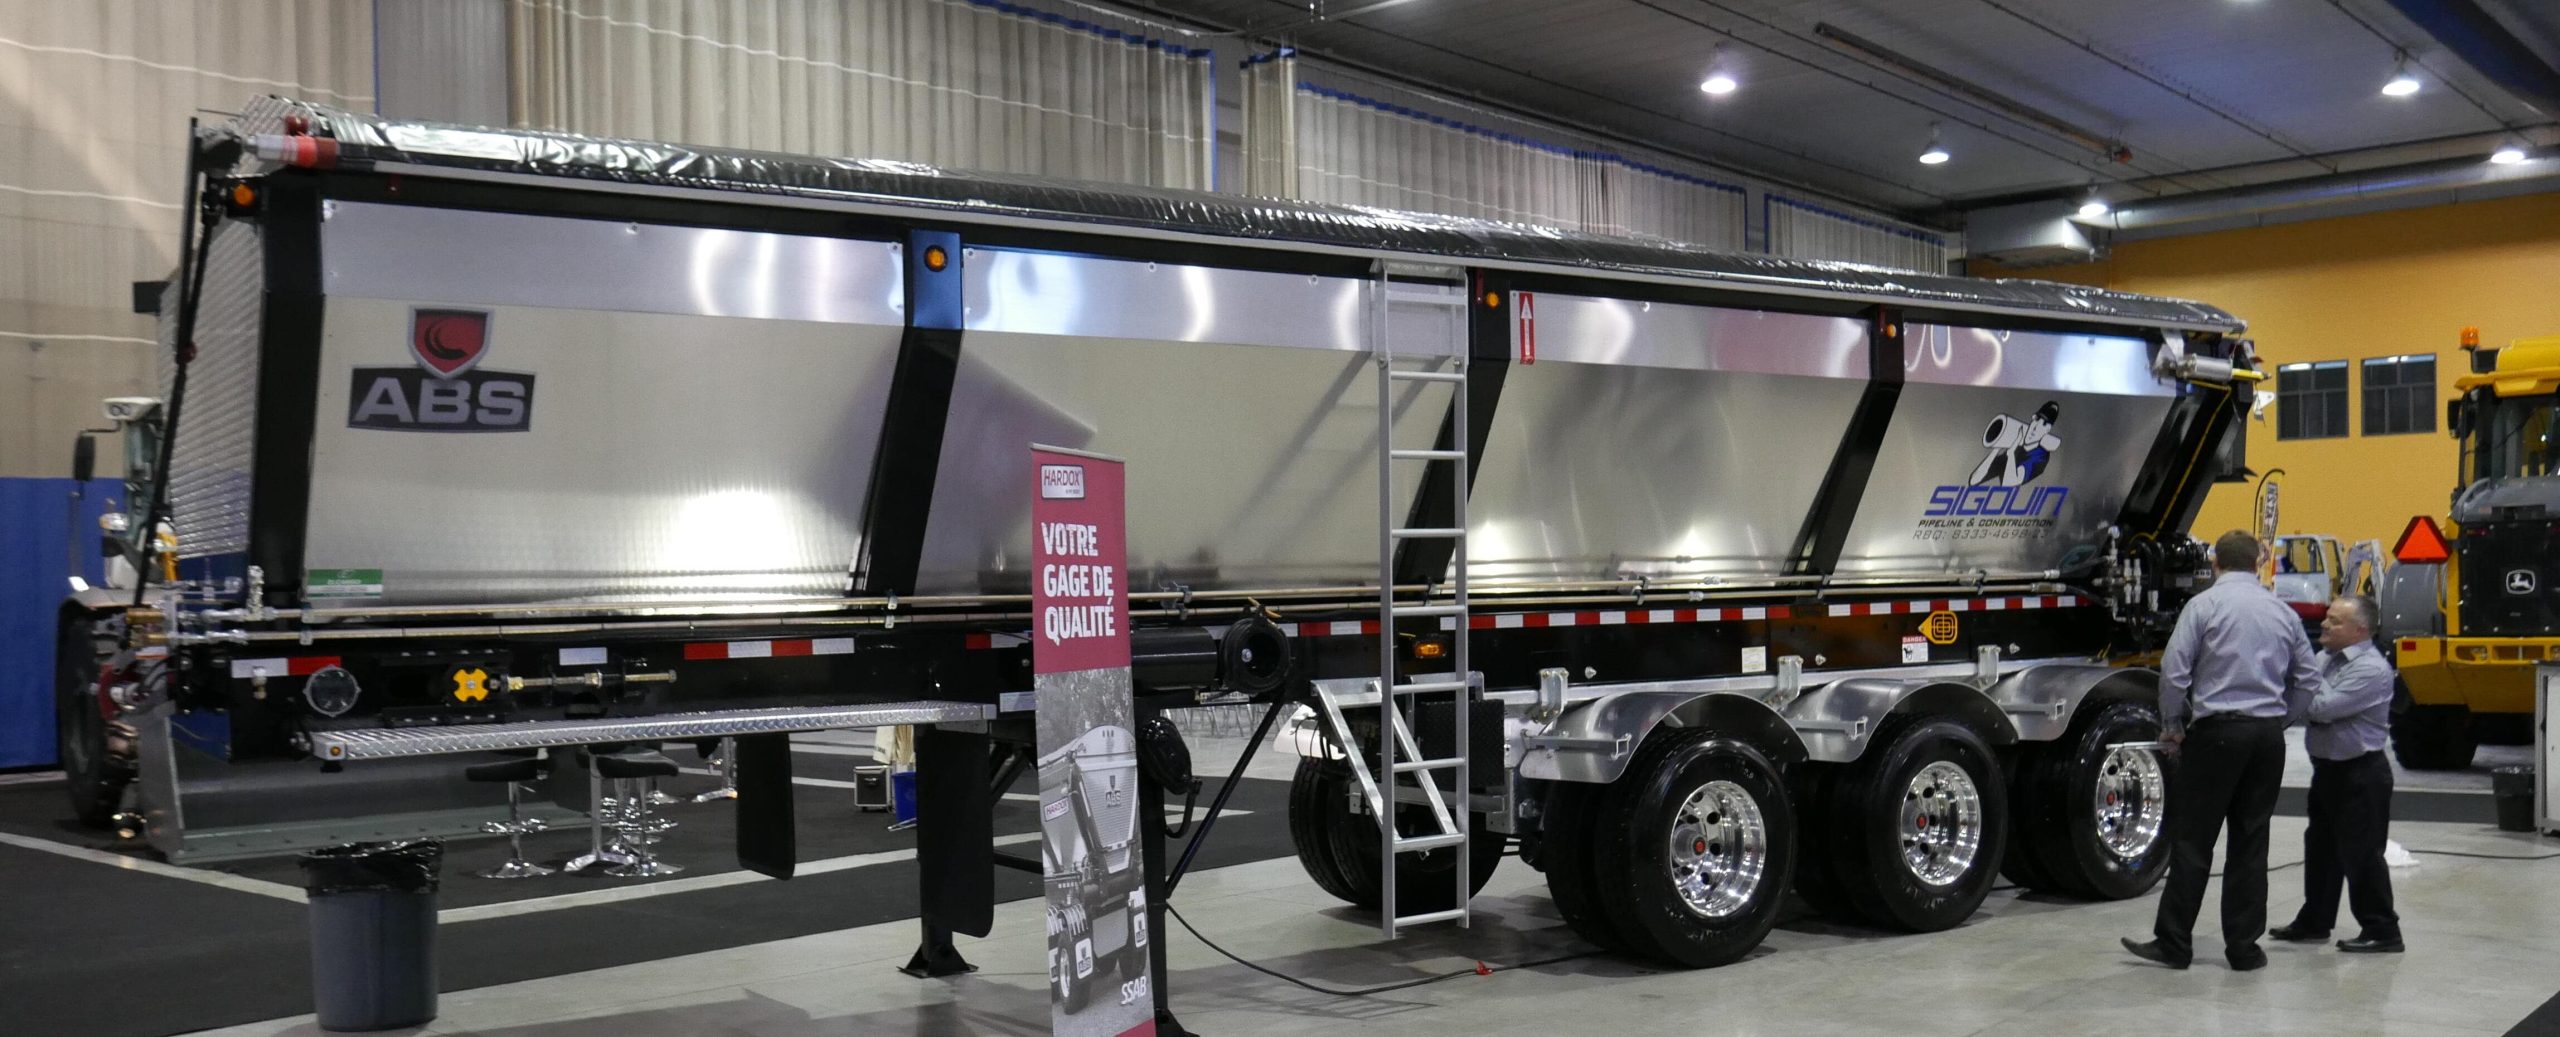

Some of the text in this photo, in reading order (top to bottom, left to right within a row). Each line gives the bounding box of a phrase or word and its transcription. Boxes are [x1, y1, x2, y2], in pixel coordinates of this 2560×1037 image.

[354, 376, 526, 426] ABS
[1043, 469, 1080, 486] HARDOX
[1924, 485, 2069, 516] SIGOUIN
[1912, 529, 1948, 541] RBQ:
[1918, 517, 2054, 528] PIPELINE & CONSTRUCTION
[1041, 522, 1098, 556] VOTRE
[1043, 564, 1114, 597] GAGE DE
[1045, 597, 1116, 646] QUALITÉ
[1121, 976, 1147, 1005] SSAB
